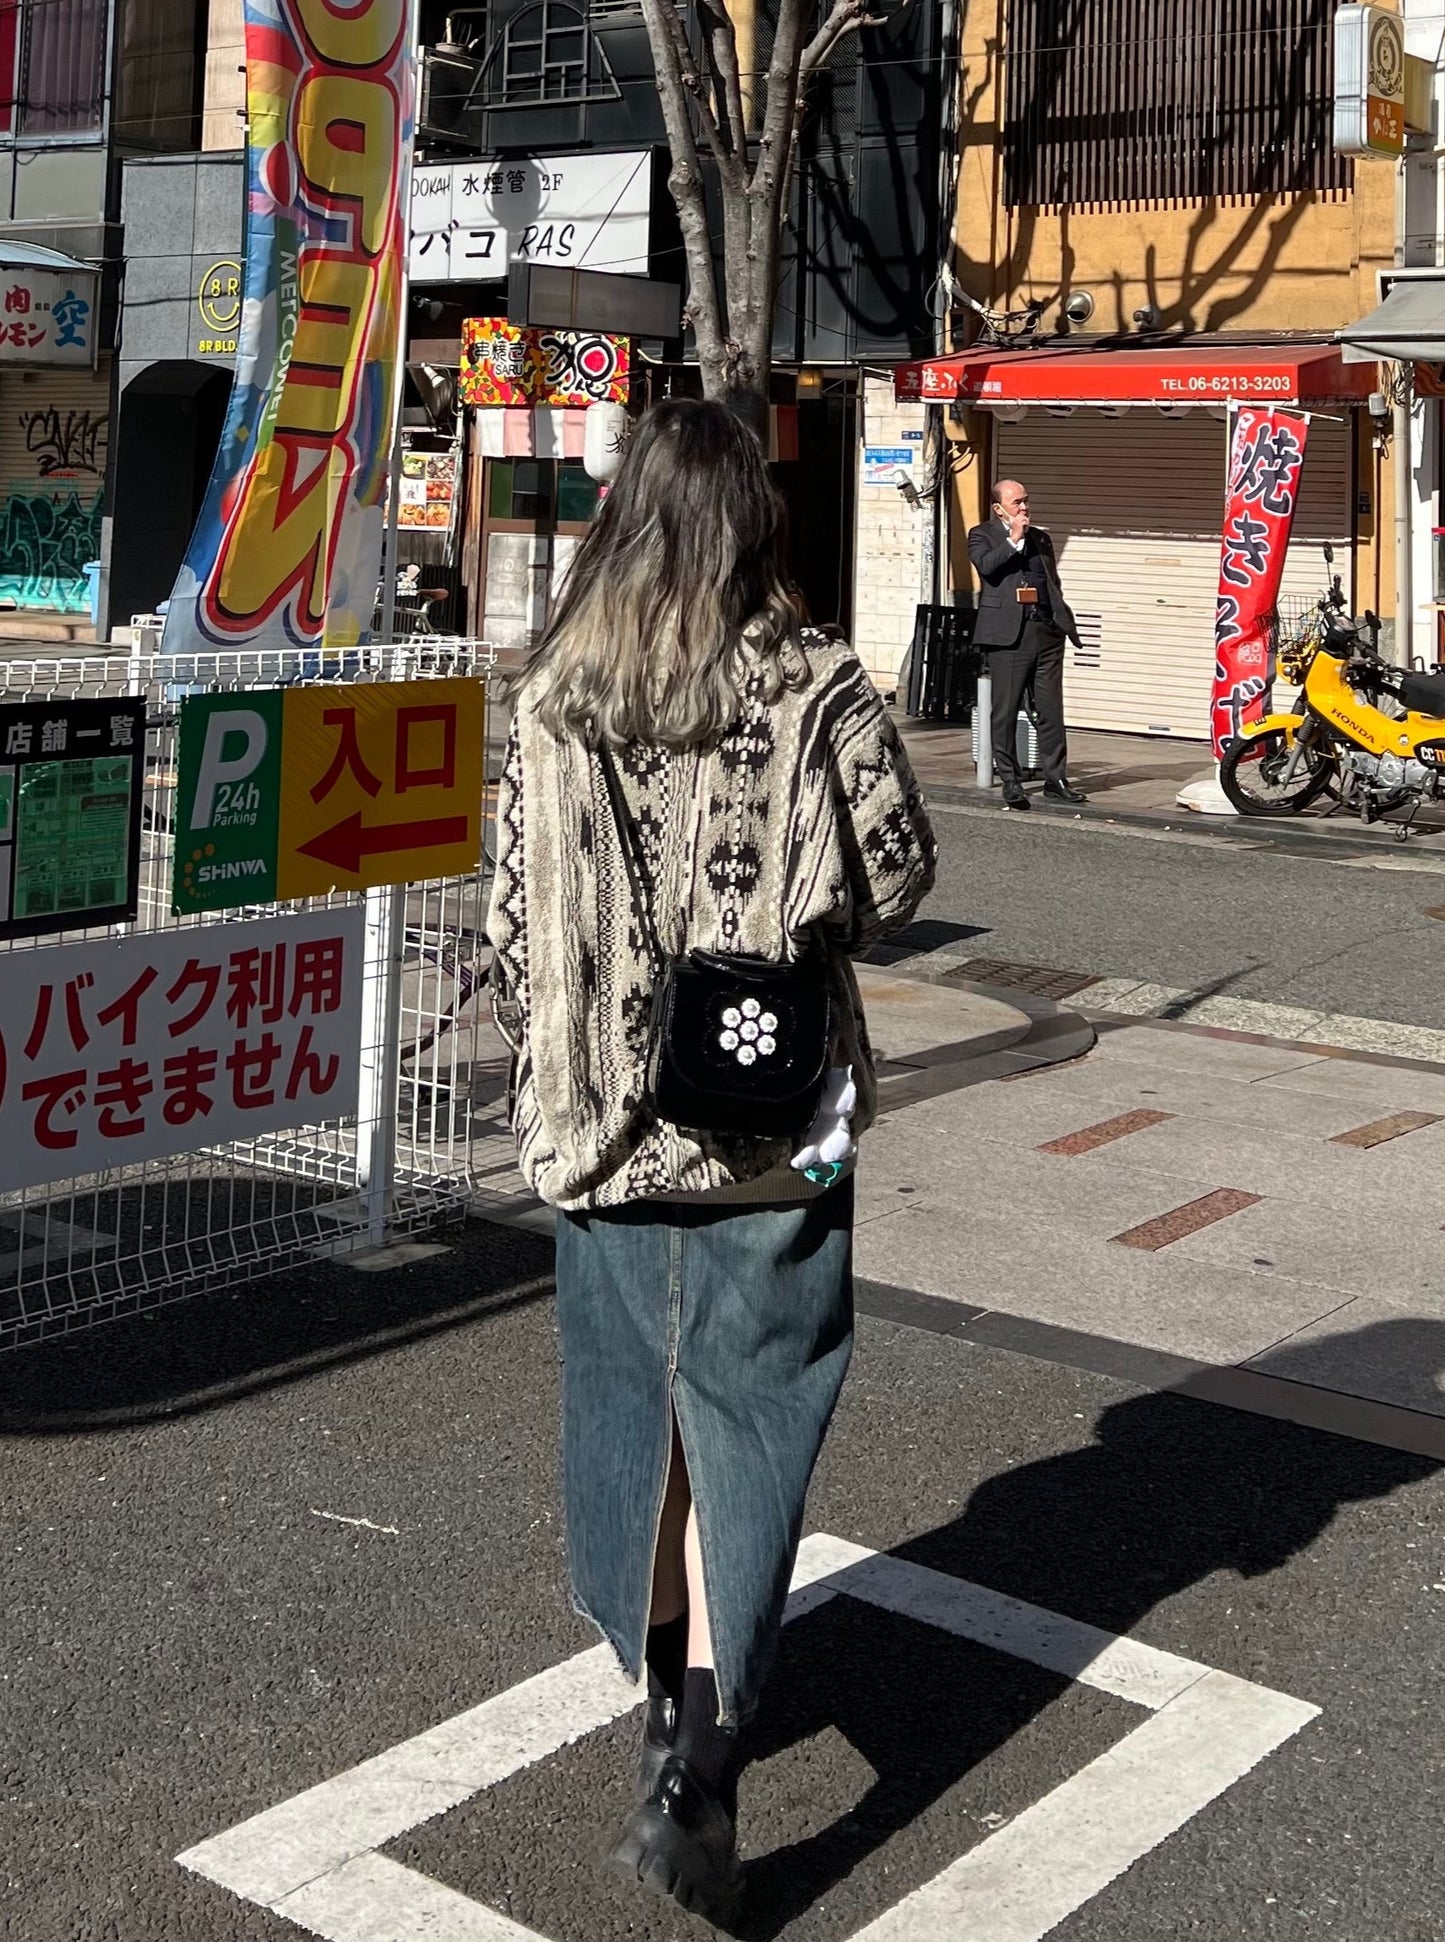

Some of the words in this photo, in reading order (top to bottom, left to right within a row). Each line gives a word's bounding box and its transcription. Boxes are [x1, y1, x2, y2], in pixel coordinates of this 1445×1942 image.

[462, 169, 526, 196] 水煙管
[542, 173, 563, 191] 2F
[410, 218, 496, 259] バコ
[517, 223, 576, 258] RAS
[472, 339, 527, 363] 串焼き
[494, 363, 524, 377] SARU
[5, 714, 135, 755] 店舗一覧
[1331, 708, 1375, 745] HONDA
[189, 709, 269, 831] P
[309, 703, 457, 805] 入口
[214, 782, 261, 814] 24h
[212, 809, 258, 827] Parking
[23, 936, 344, 1062] バイク利用
[22, 1024, 340, 1150] できません
